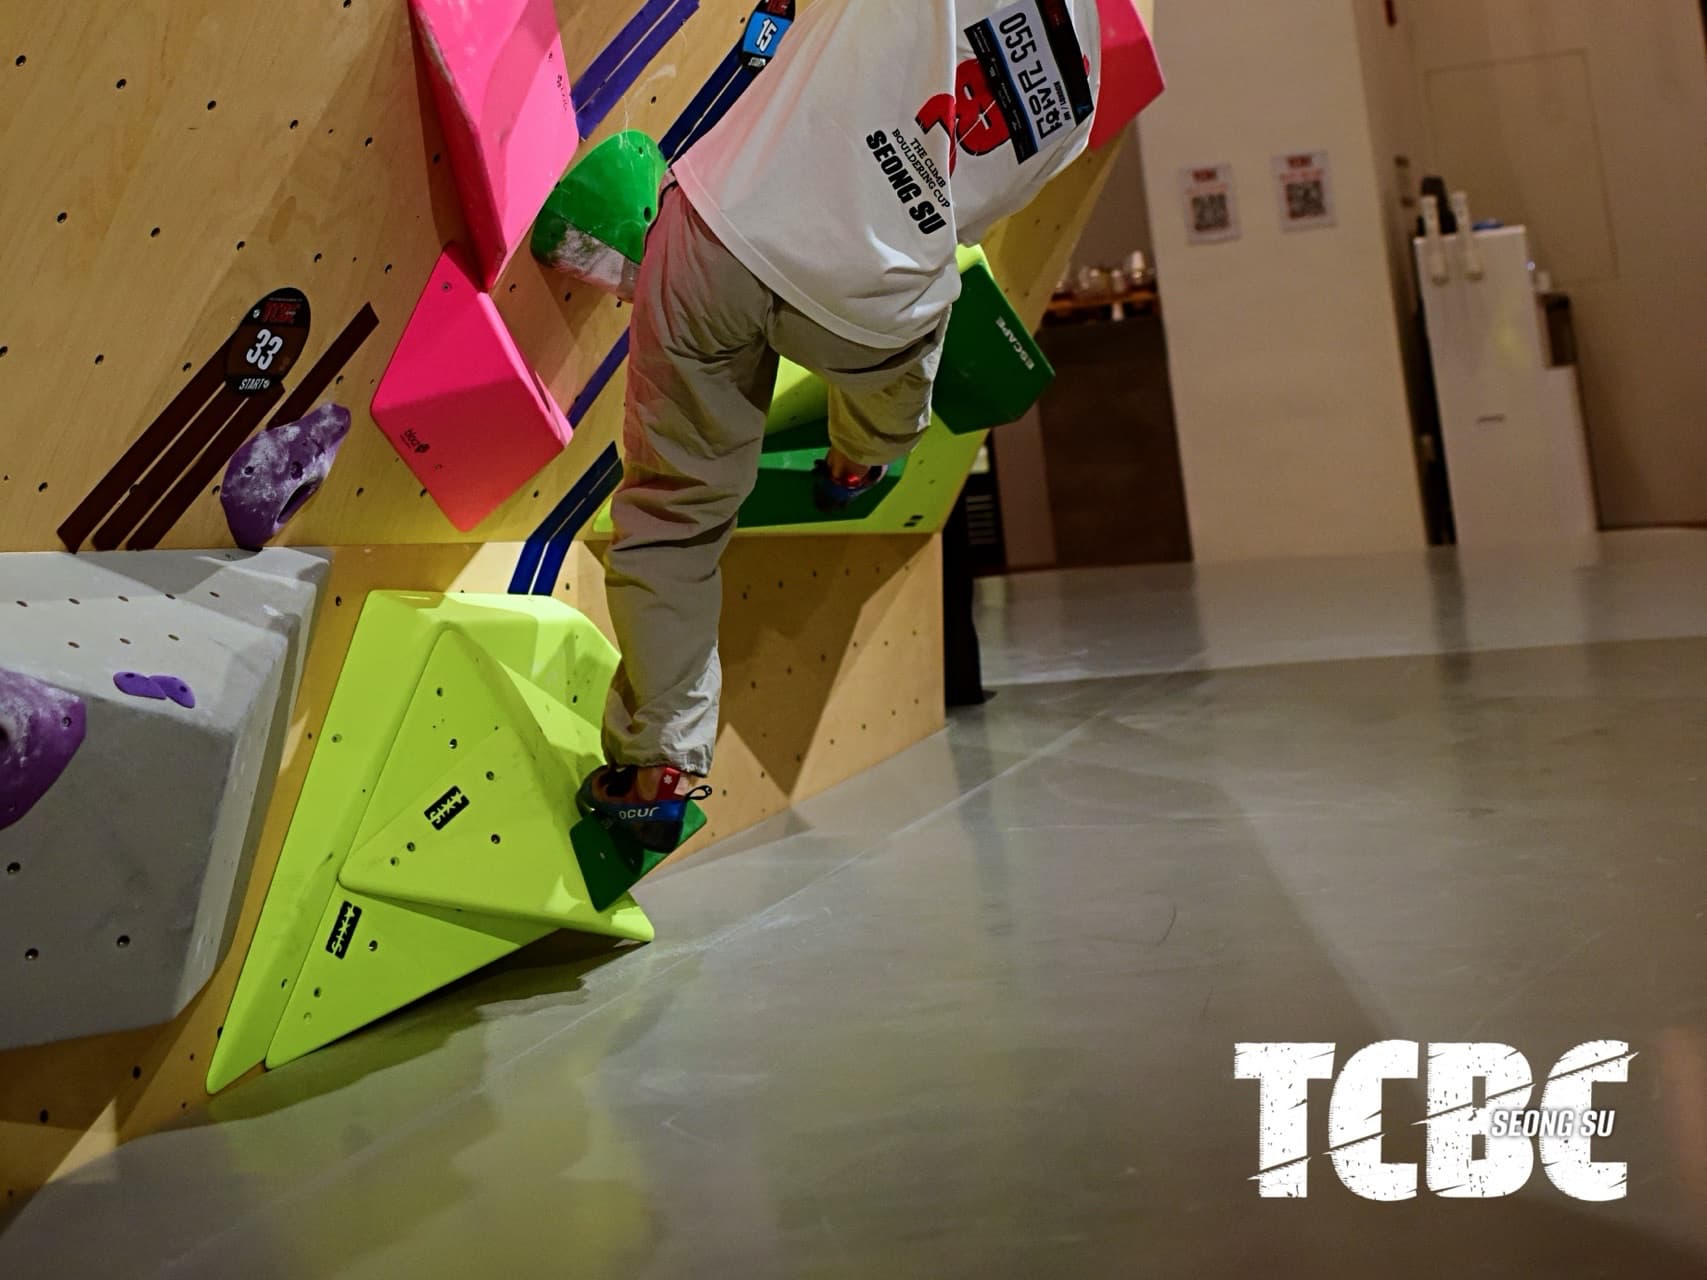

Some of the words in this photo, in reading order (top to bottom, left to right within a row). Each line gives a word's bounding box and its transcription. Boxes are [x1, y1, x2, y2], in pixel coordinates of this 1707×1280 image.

[756, 18, 778, 52] 15
[998, 12, 1037, 63] 055
[1018, 60, 1063, 140] 김성현
[865, 130, 922, 204] SEONG
[908, 200, 947, 235] SU
[892, 128, 936, 190] BOULDERING
[933, 189, 951, 208] CUP
[910, 137, 928, 159] THE
[924, 158, 946, 188] CLIMB
[246, 328, 283, 370] 33
[239, 378, 265, 390] START
